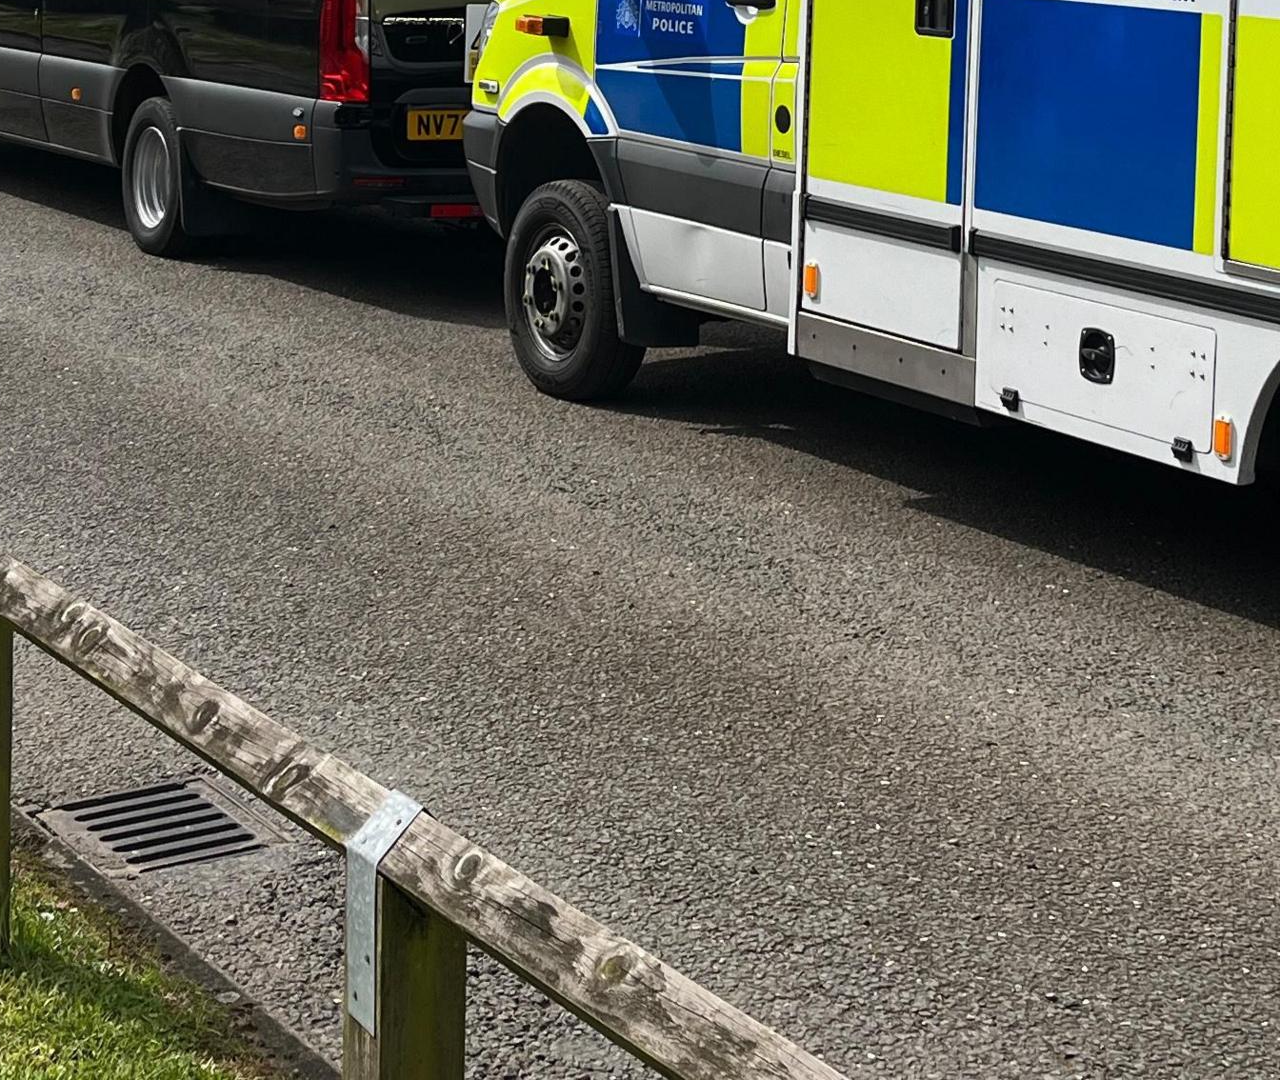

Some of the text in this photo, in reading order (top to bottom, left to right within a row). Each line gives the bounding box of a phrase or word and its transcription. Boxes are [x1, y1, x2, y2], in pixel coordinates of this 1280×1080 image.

[645, 0, 703, 17] METROPOLITAN
[652, 17, 695, 35] POLICE
[417, 113, 468, 137] NV7
